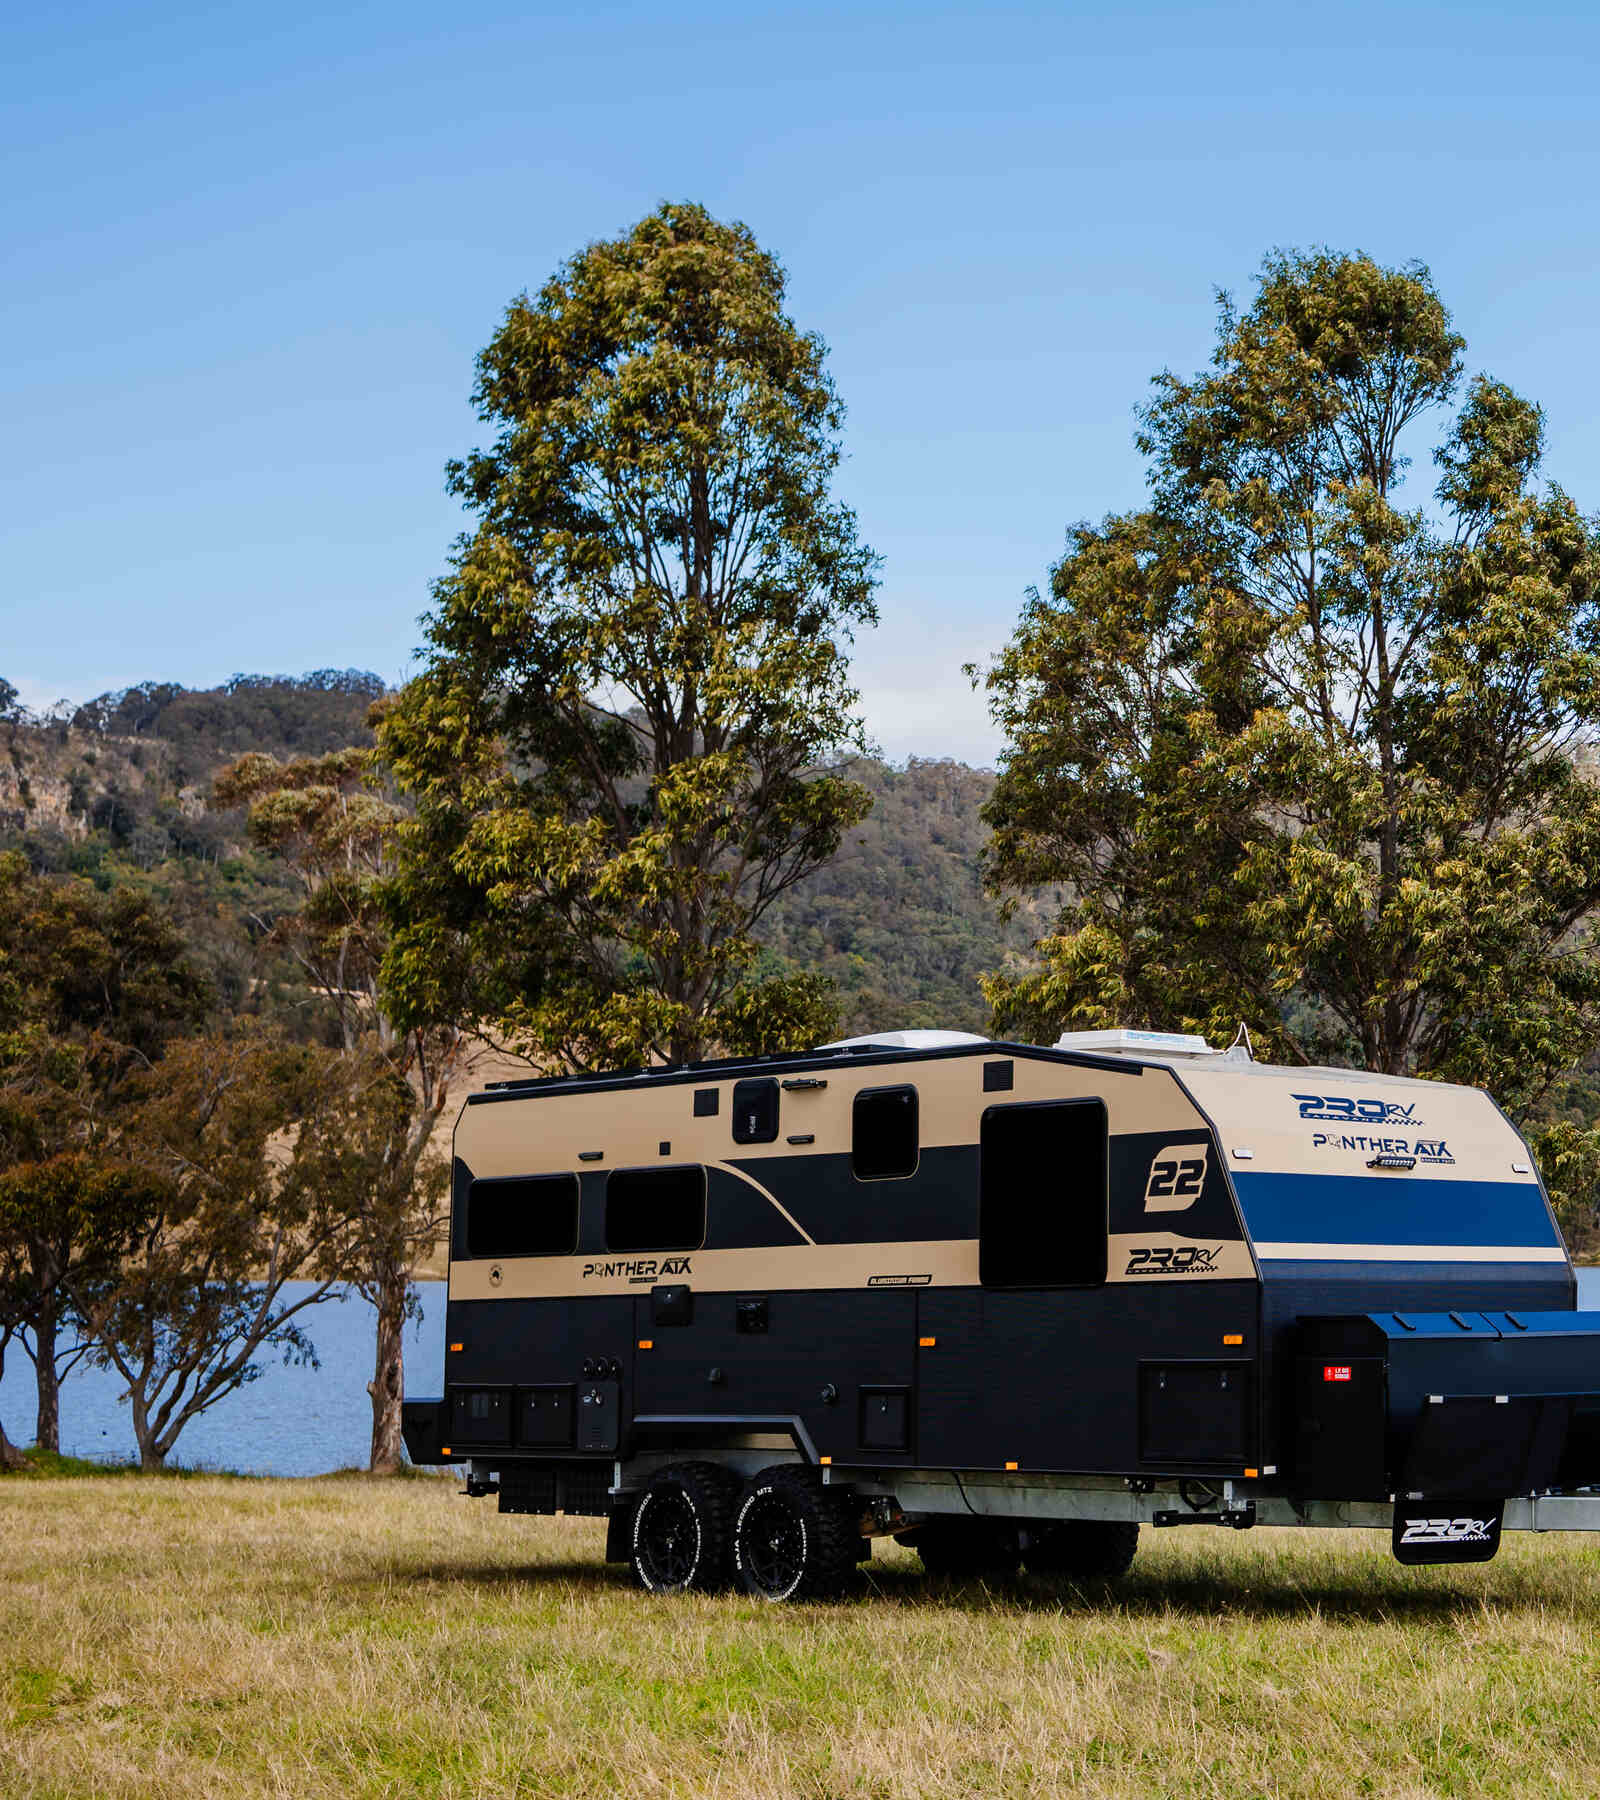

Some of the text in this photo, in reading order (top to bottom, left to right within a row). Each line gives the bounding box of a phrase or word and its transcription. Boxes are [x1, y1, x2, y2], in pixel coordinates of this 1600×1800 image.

[1290, 1093, 1415, 1120] PRO RV
[1148, 1160, 1204, 1196] 22
[1128, 1246, 1223, 1268] PRO RV
[1402, 1517, 1497, 1537] PRO RV
